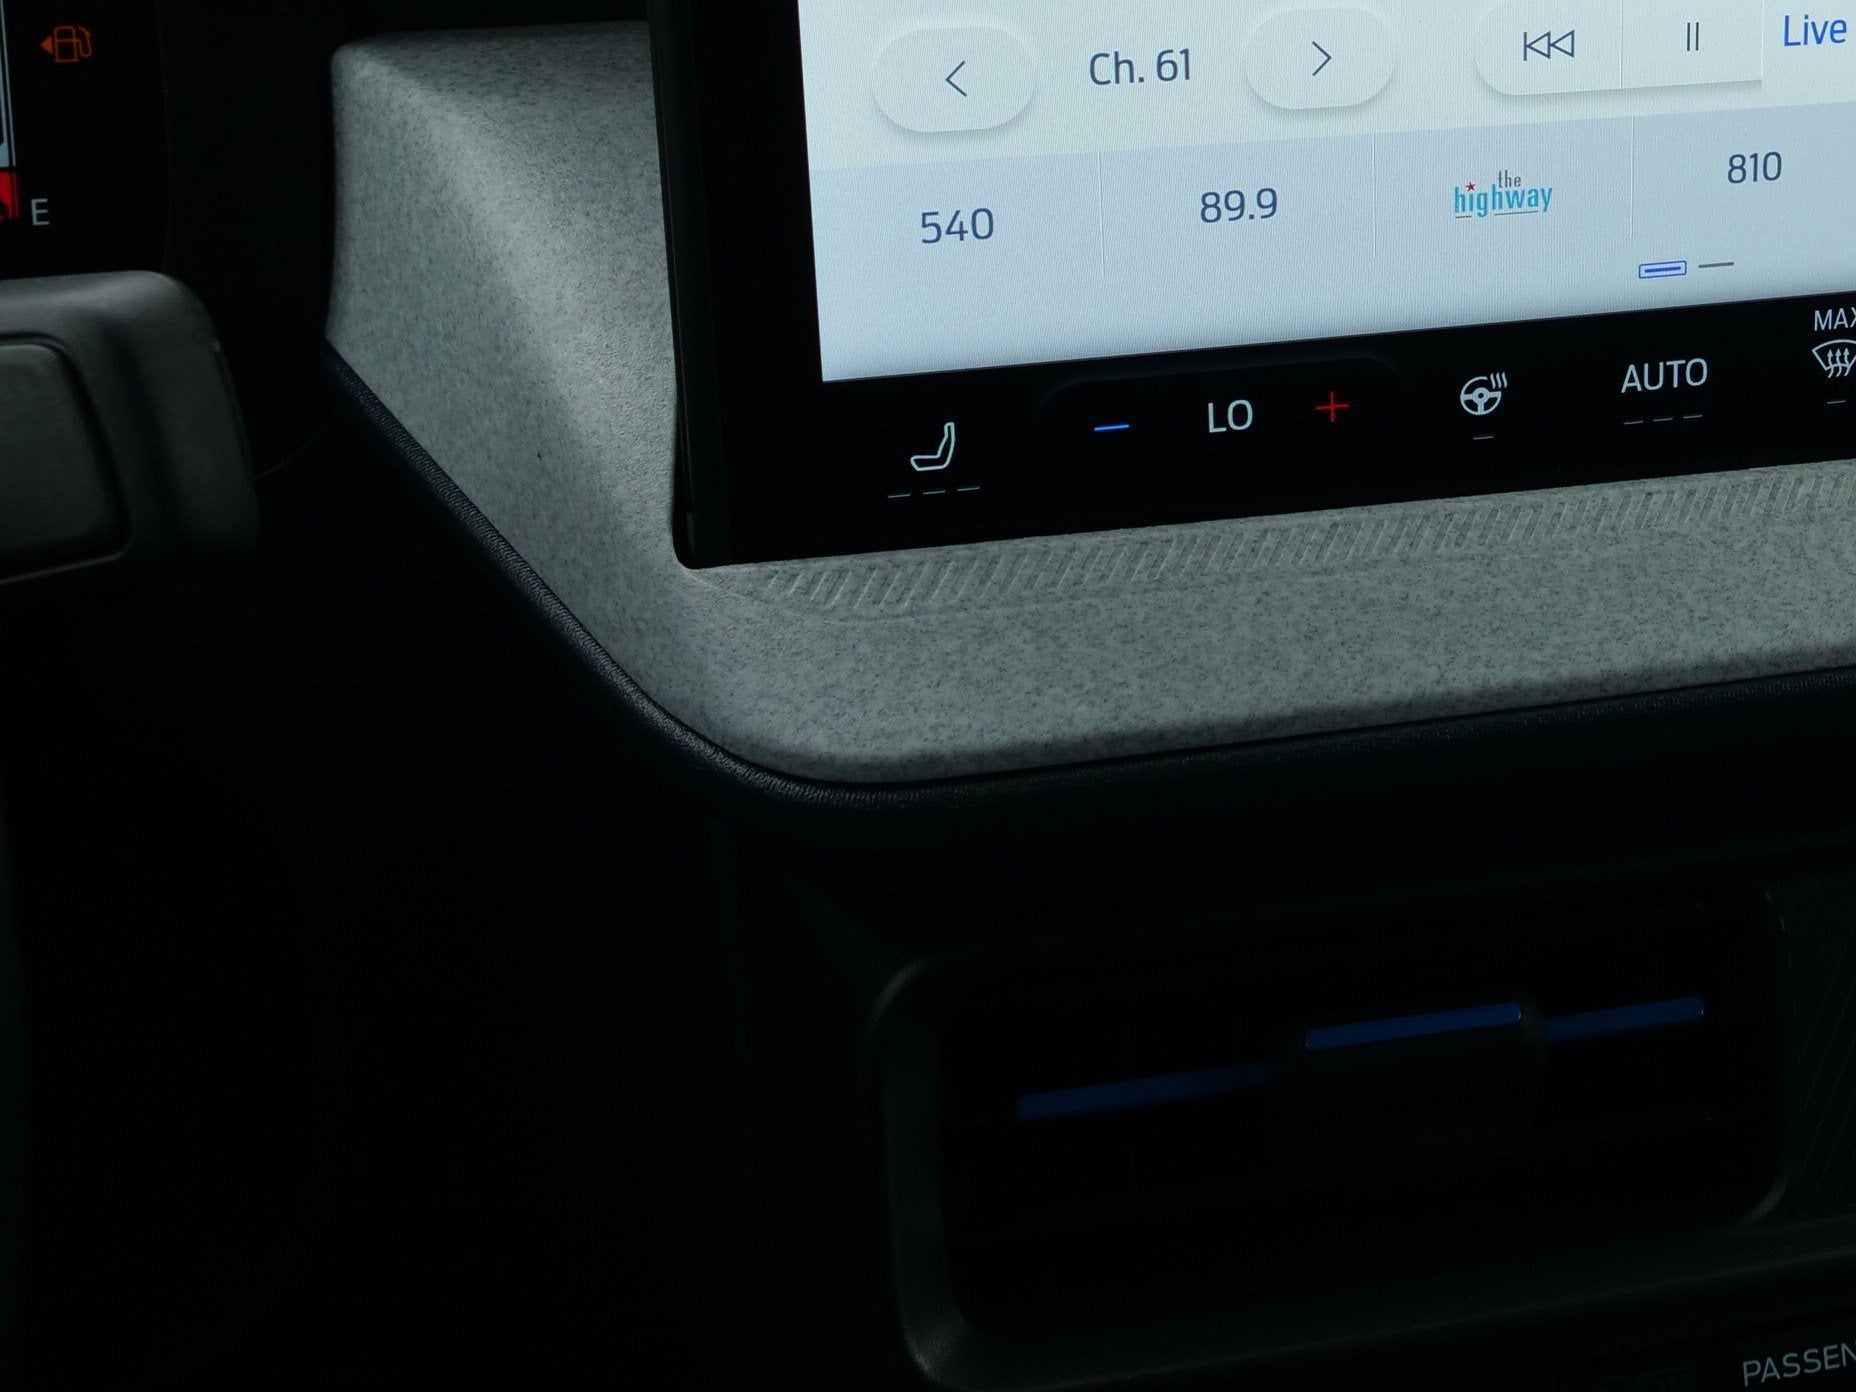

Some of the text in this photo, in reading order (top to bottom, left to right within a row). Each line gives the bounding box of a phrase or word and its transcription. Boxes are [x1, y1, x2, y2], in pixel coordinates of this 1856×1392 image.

[1783, 14, 1847, 46] Live
[1088, 48, 1192, 86] Ch. 61
[1498, 169, 1521, 188] the
[1727, 151, 1782, 185] 810
[31, 198, 50, 226] E
[1200, 188, 1279, 225] 89.9
[1454, 183, 1553, 218] highway
[920, 208, 995, 244] 540
[1620, 356, 1708, 394] AUTO
[1207, 400, 1254, 433] LO
